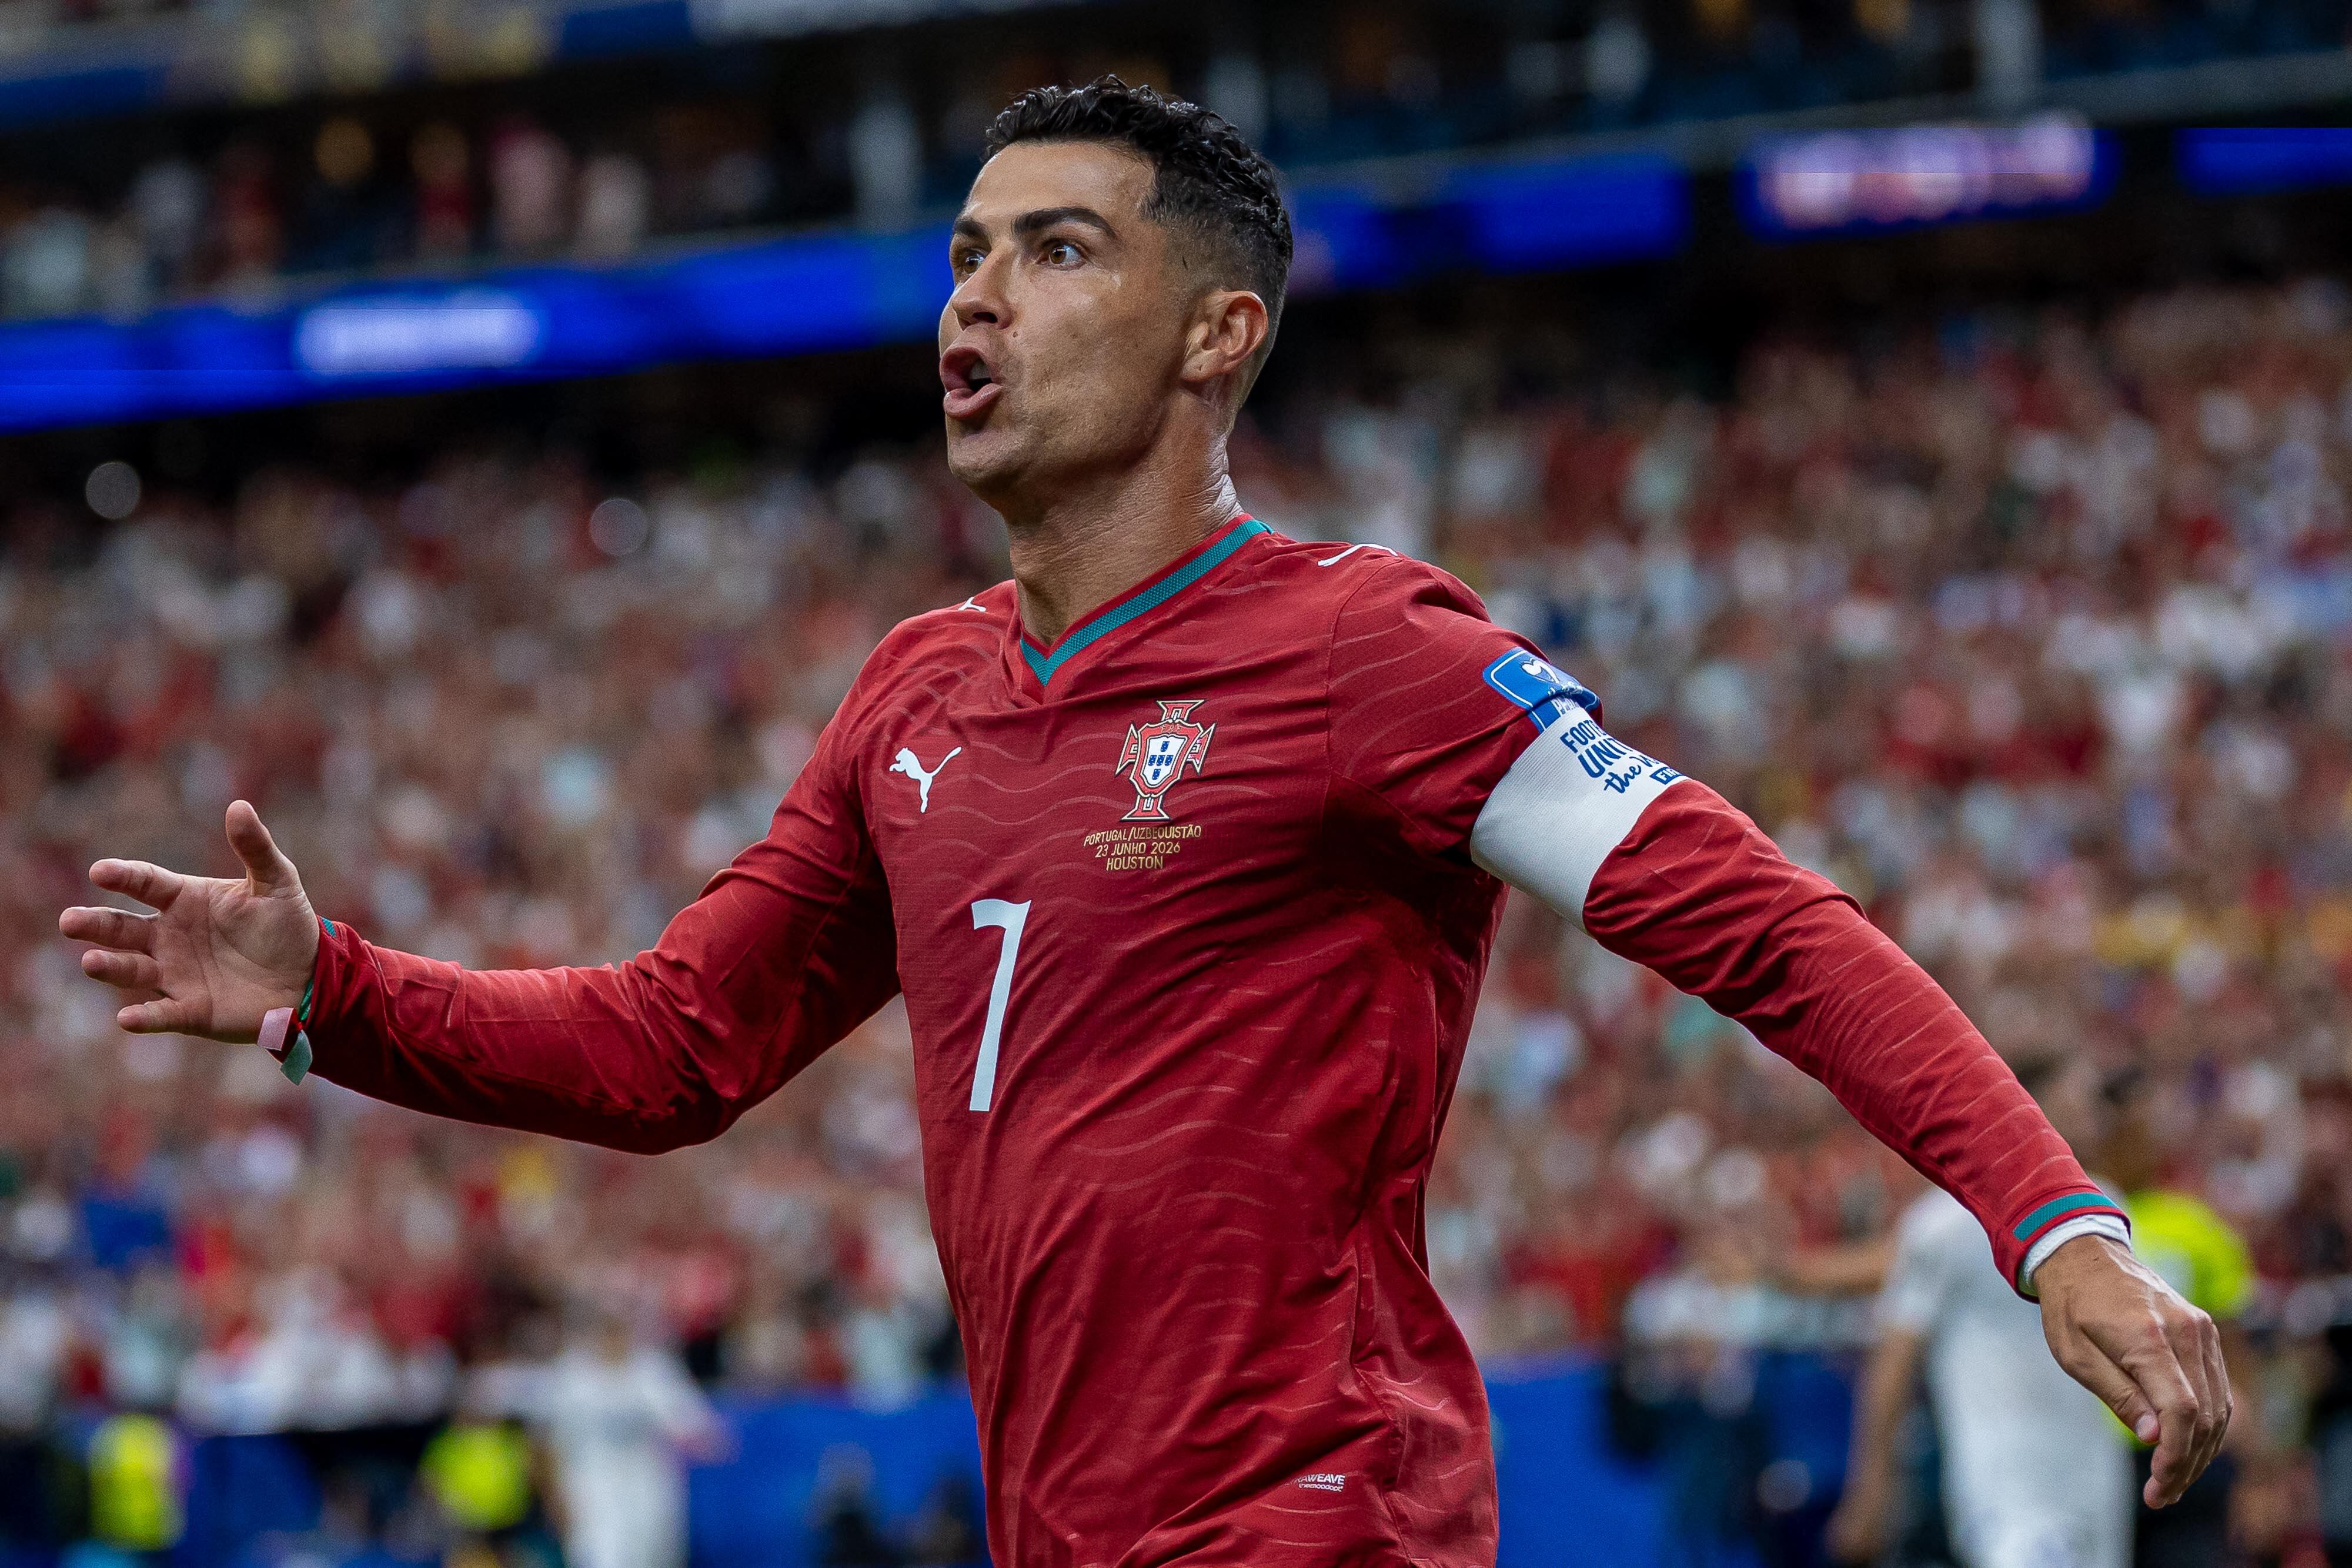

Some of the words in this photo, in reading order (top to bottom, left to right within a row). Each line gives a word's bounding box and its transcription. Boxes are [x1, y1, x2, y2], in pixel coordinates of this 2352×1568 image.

[1603, 764, 1642, 794] the
[1083, 824, 1202, 847] PORTUGAL/UZBEQUISTÃO
[1095, 844, 1108, 858] 23
[1111, 842, 1146, 856] JUNHO
[1150, 841, 1181, 854] 2026
[1106, 855, 1164, 871] HOUSTON
[969, 898, 1031, 1112] 7
